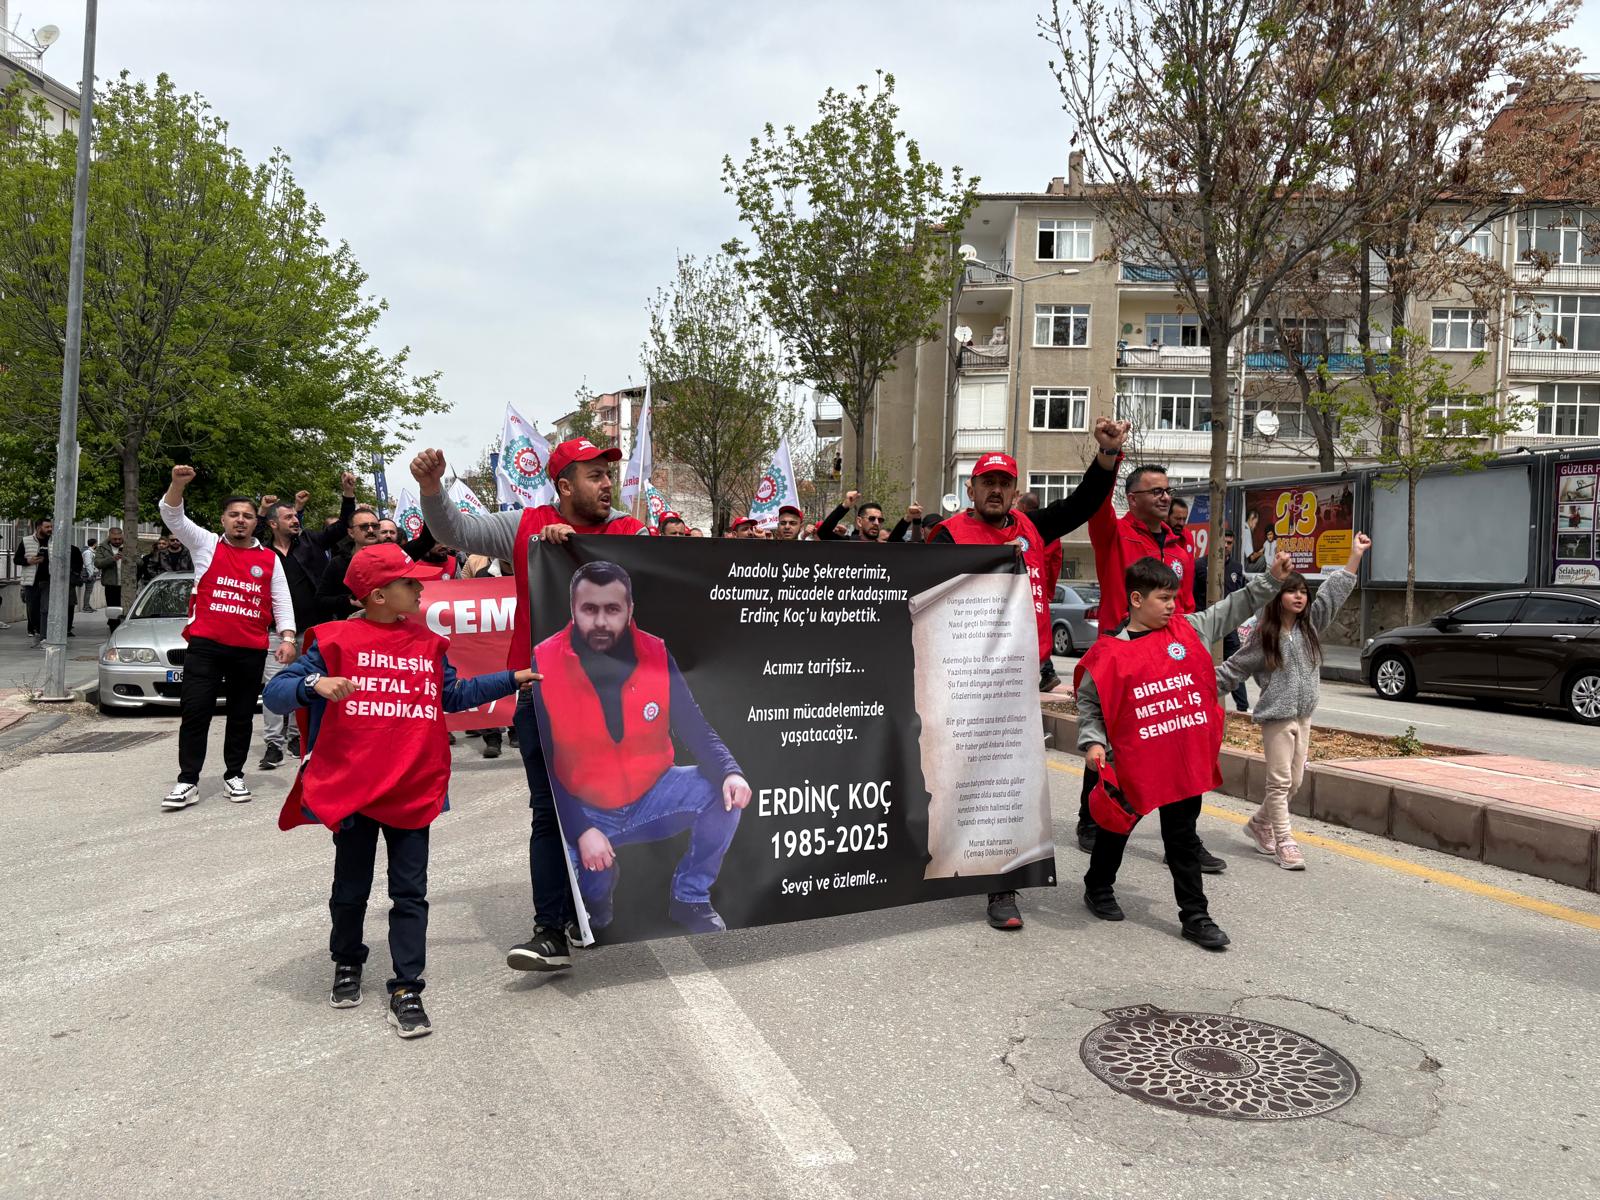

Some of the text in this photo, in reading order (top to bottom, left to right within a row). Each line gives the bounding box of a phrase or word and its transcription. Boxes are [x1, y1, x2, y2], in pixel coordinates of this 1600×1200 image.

[1561, 464, 1593, 475] GÜZLER
[1274, 490, 1317, 536] 23
[728, 562, 891, 583] Anadolu Şube Şekreterimiz,
[217, 576, 262, 593] BİRLEŞİK
[212, 589, 245, 602] METAL
[252, 595, 261, 607] İŞ
[709, 585, 908, 604] dostumuz, mücadele arkadaşımız
[209, 602, 260, 618] SENDİKASI
[740, 607, 779, 626] Erdinç
[820, 608, 880, 626] kaybettik.
[973, 608, 989, 617] gelip
[357, 650, 434, 674] BİRLEŞİK
[763, 660, 804, 675] Acımız
[942, 657, 972, 665] Ademoğlu
[947, 668, 972, 676] Yazılmış
[351, 676, 410, 693] METAL
[424, 678, 437, 700] İŞ
[1133, 672, 1194, 700] BİRLEŞİK
[345, 700, 437, 721] SENDİKASI
[747, 701, 884, 722] Anısını mücadelemizde
[1135, 697, 1182, 720] METAL
[1187, 691, 1202, 707] İŞ
[1138, 711, 1208, 740] SENDİKASI
[781, 724, 858, 747] yaşatacağız.
[996, 777, 1009, 785] soldu
[758, 779, 892, 819] ERDİNÇ KOÇ
[981, 791, 991, 799] oldu
[977, 817, 995, 826] emekçi
[771, 822, 888, 859] 1985-2025
[986, 838, 1013, 846] Kahraman
[782, 875, 813, 896] Sevgi
[816, 878, 830, 890] ve
